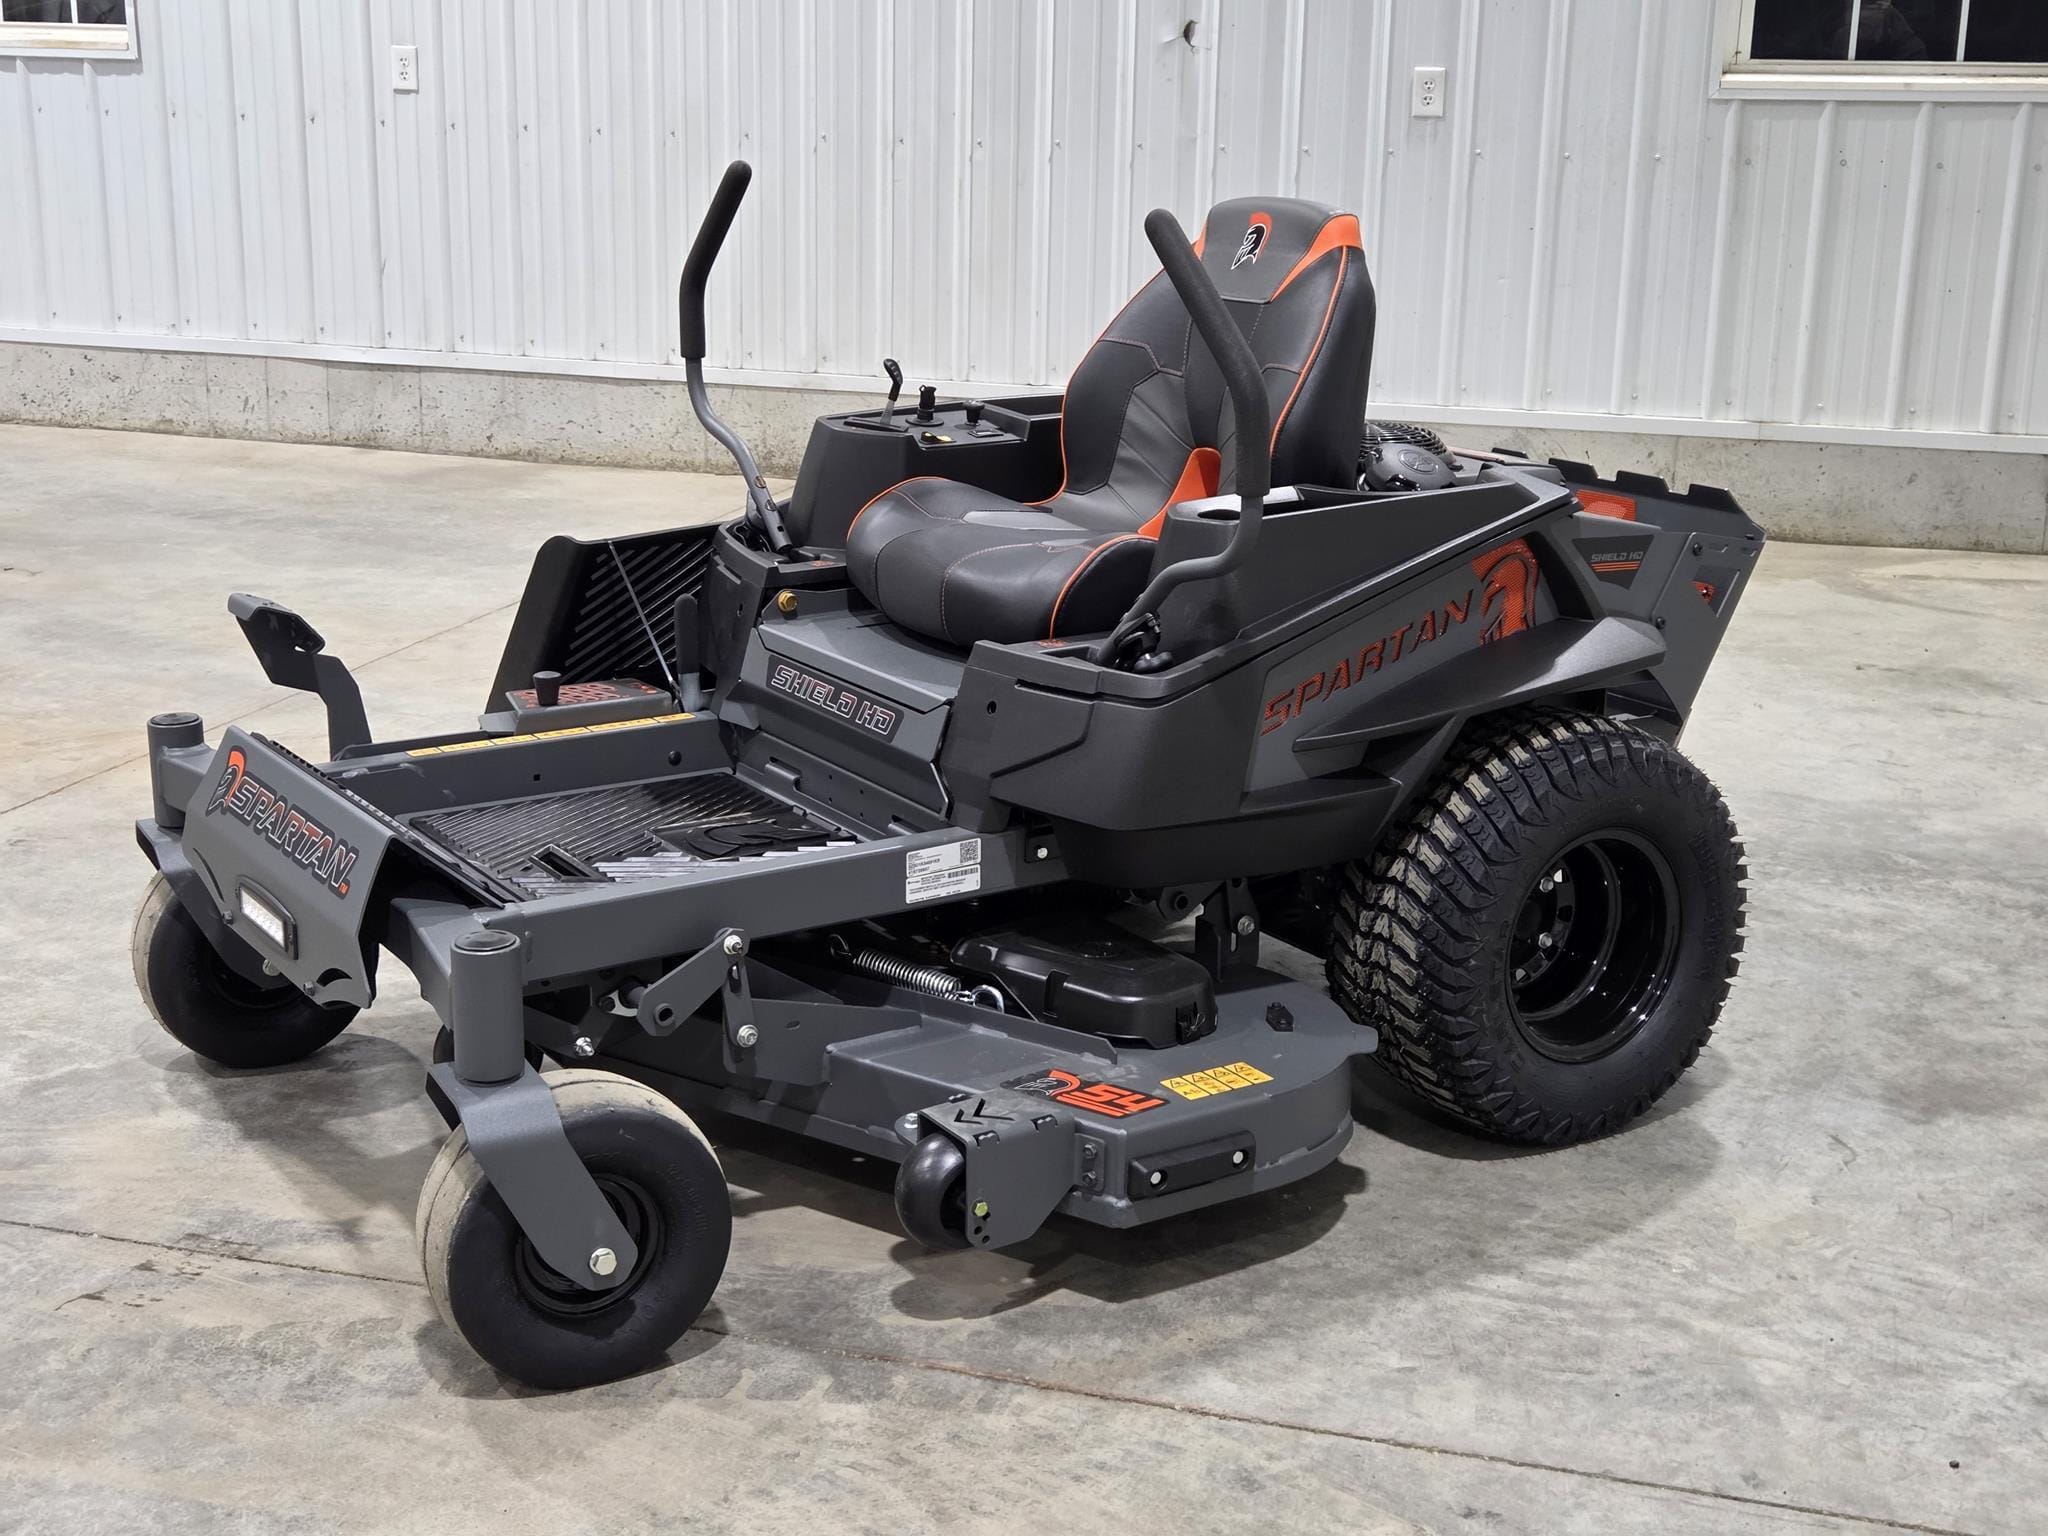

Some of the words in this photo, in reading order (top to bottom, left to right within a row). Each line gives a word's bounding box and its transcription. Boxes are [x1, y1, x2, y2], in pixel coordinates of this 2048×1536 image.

[1591, 552, 1627, 562] SHIELD
[1629, 551, 1644, 561] HD
[771, 664, 858, 719] SHIELD
[855, 701, 896, 735] HD
[1260, 588, 1474, 736] SPARTAN
[228, 776, 359, 886] SPARTAN
